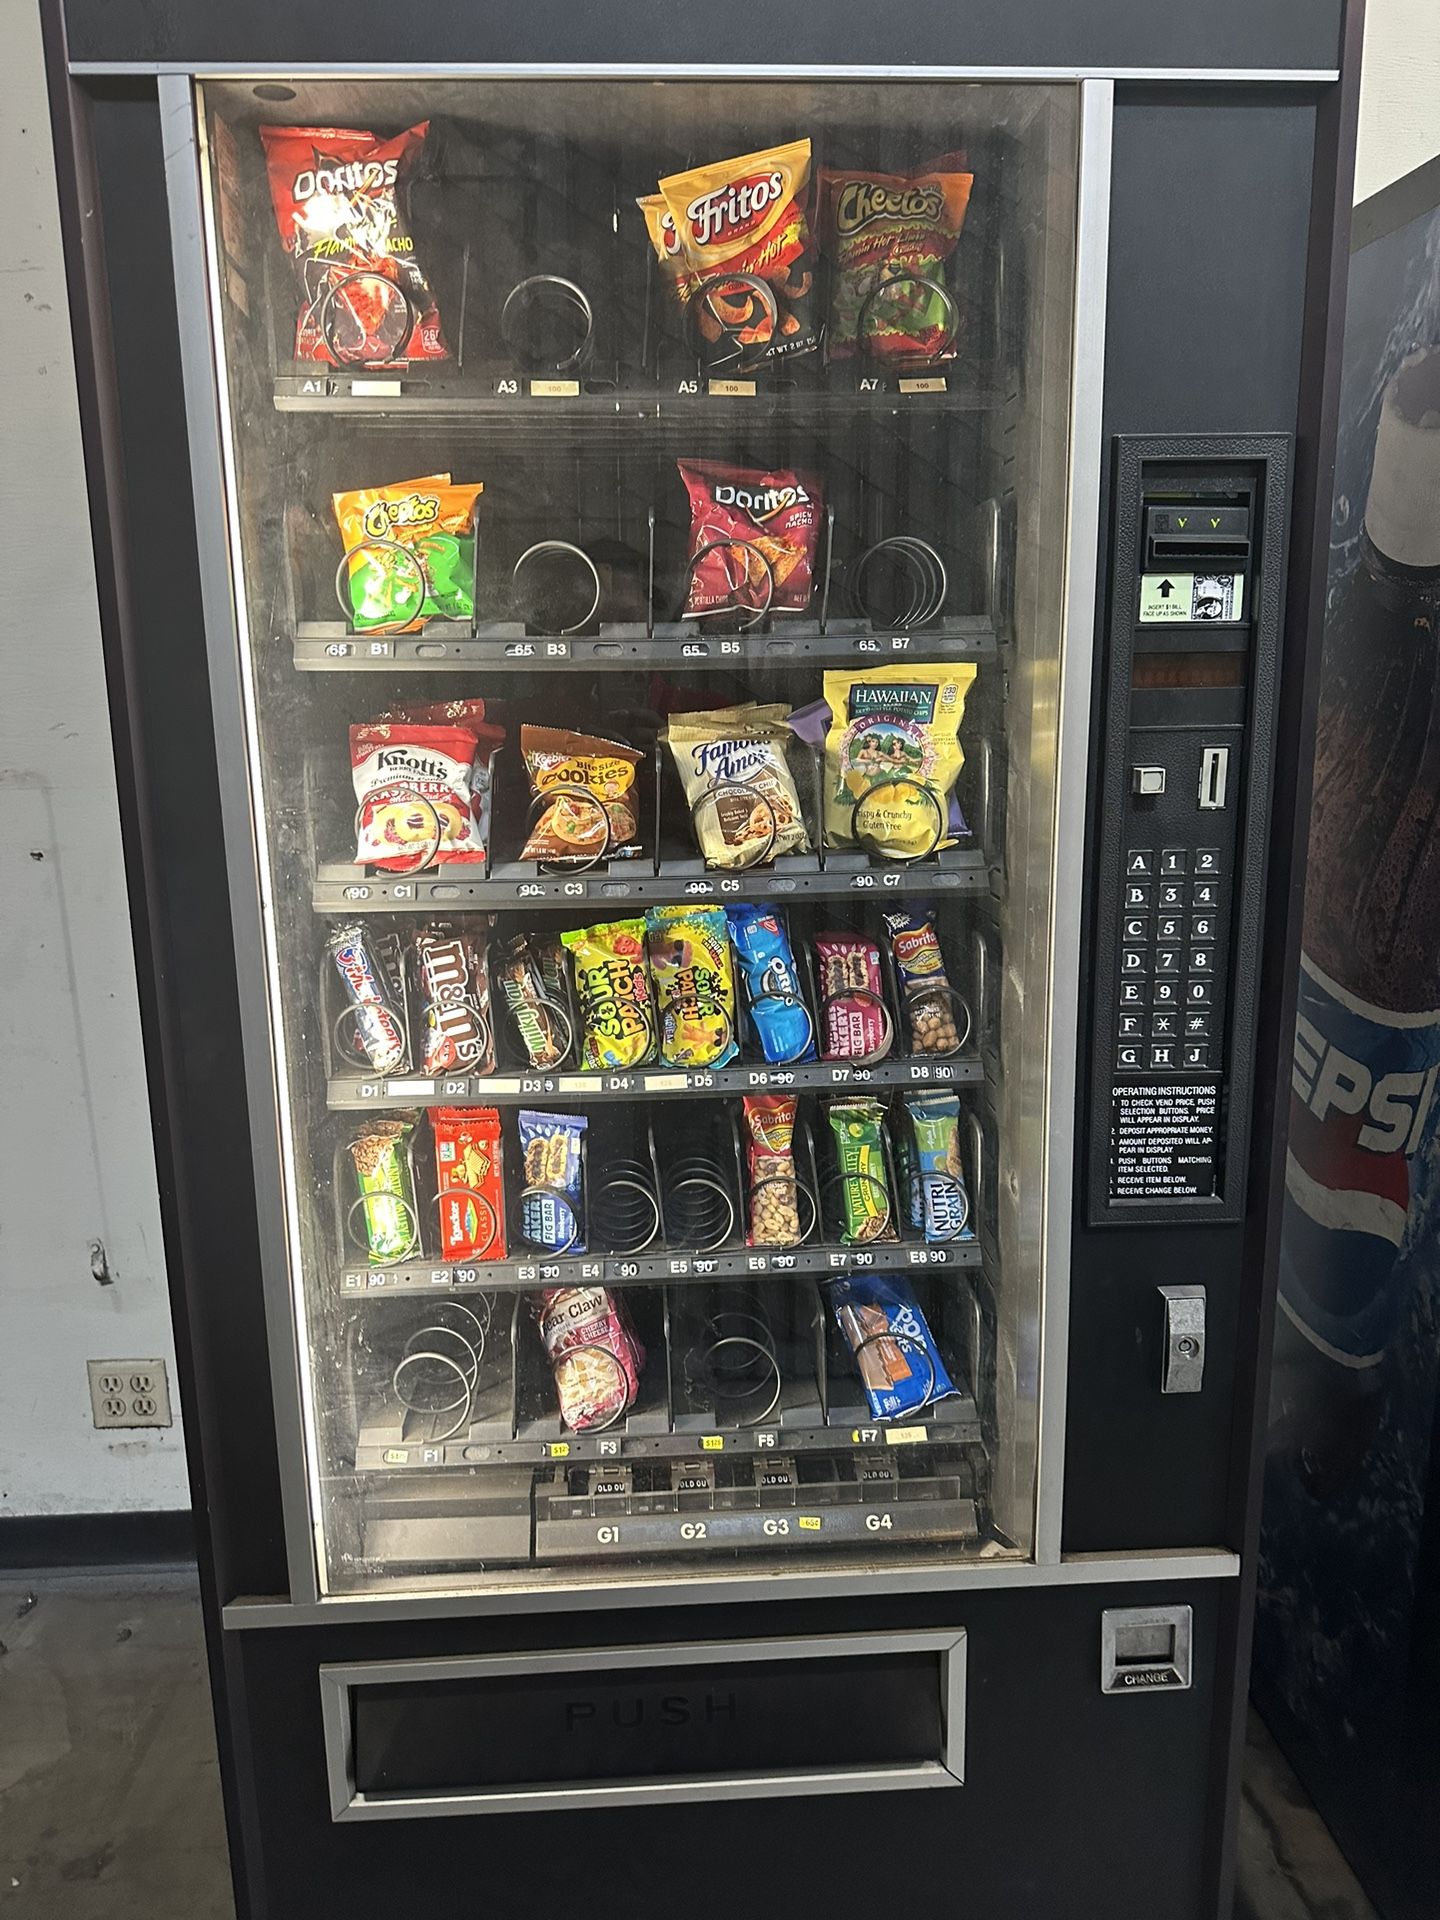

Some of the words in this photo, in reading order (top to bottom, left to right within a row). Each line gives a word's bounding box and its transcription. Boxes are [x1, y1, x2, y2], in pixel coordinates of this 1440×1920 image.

[687, 171, 783, 245] Fritos
[838, 182, 941, 230] Cheetos
[385, 237, 414, 252] ACHO
[302, 380, 322, 393] A1
[497, 380, 518, 393] A3
[678, 380, 698, 394] A5
[725, 384, 739, 393] 100
[859, 378, 879, 391] A7
[915, 382, 930, 390] 100
[715, 485, 810, 511] Doritos
[366, 494, 438, 538] Cheetos
[371, 643, 389, 655] B1
[548, 643, 566, 656] B3
[721, 642, 740, 653] B5
[859, 640, 876, 651] 65
[892, 637, 909, 649] B7
[856, 689, 931, 703] HAWAIIAN
[860, 715, 920, 740] ORIGINAL
[377, 749, 448, 780] Knott's
[883, 810, 912, 820] Crunchy
[1132, 856, 1146, 869] A
[1168, 856, 1176, 868] 1
[1201, 855, 1213, 867] 2
[721, 879, 740, 891] C5
[856, 876, 873, 887] 90
[883, 875, 901, 886] C7
[394, 886, 411, 898] C1
[564, 883, 583, 895] C3
[1130, 889, 1144, 902] B
[1165, 888, 1177, 901] 3
[1199, 888, 1210, 901] 4
[1128, 921, 1142, 935] C
[1163, 921, 1175, 934] 5
[1197, 920, 1208, 933] 6
[1126, 954, 1140, 967] D
[1162, 954, 1173, 966] 7
[1195, 953, 1206, 966] 8
[588, 968, 621, 1036] SOUR
[608, 960, 645, 1036] PATCH
[1125, 986, 1139, 999] E
[1159, 986, 1171, 998] 9
[1193, 985, 1204, 998] 0
[852, 1015, 862, 1036] BAR
[1123, 1018, 1137, 1031] F
[1189, 1018, 1204, 1029] #
[838, 1006, 850, 1057] AKERY
[852, 1037, 863, 1056] FIG
[1121, 1050, 1136, 1062] G
[1154, 1050, 1169, 1062] H
[1189, 1049, 1200, 1061] J
[749, 1072, 768, 1084] D6
[832, 1070, 850, 1081] D7
[854, 1070, 871, 1081] 90
[911, 1066, 930, 1078] D8
[523, 1079, 541, 1091] D3
[610, 1077, 629, 1088] D4
[694, 1075, 713, 1086] D5
[1292, 1010, 1440, 1155] EPSI
[362, 1085, 378, 1097] D1
[446, 1082, 465, 1093] D2
[1112, 1087, 1157, 1096] OPERATING
[1158, 1086, 1216, 1096] INSTRUCTIONS
[1120, 1116, 1135, 1124] WILL
[1119, 1127, 1146, 1135] DEPOSIT
[1185, 1137, 1200, 1145] WILL
[1118, 1157, 1136, 1165] PUSH
[1178, 1156, 1212, 1164] MATCHING
[1117, 1176, 1144, 1184] RECEIVE
[1117, 1187, 1144, 1195] RECEIVE
[544, 1202, 553, 1222] BAR
[932, 1182, 949, 1232] NUTRI
[544, 1222, 553, 1241] FIG
[749, 1258, 766, 1269] E6
[778, 1256, 794, 1267] 90
[830, 1254, 846, 1266] E7
[857, 1253, 872, 1264] 90
[910, 1252, 927, 1263] E8
[930, 1252, 946, 1263] 90
[518, 1267, 536, 1279] E3
[544, 1266, 560, 1277] 90
[582, 1264, 599, 1276] E4
[621, 1264, 637, 1275] 90
[671, 1260, 688, 1272] E5
[346, 1275, 361, 1287] E1
[369, 1273, 385, 1285] 90
[431, 1271, 448, 1283] E2
[459, 1270, 476, 1282] 90
[568, 1295, 603, 1318] Claw
[758, 1434, 775, 1447] F5
[861, 1430, 878, 1442] F7
[600, 1441, 617, 1454] F3
[423, 1450, 438, 1462] F1
[763, 1519, 790, 1535] G3
[865, 1514, 893, 1531] G4
[597, 1527, 619, 1542] G1
[680, 1522, 707, 1539] G2
[1124, 1672, 1169, 1685] CHANGE
[566, 1691, 737, 1733] PUSH
